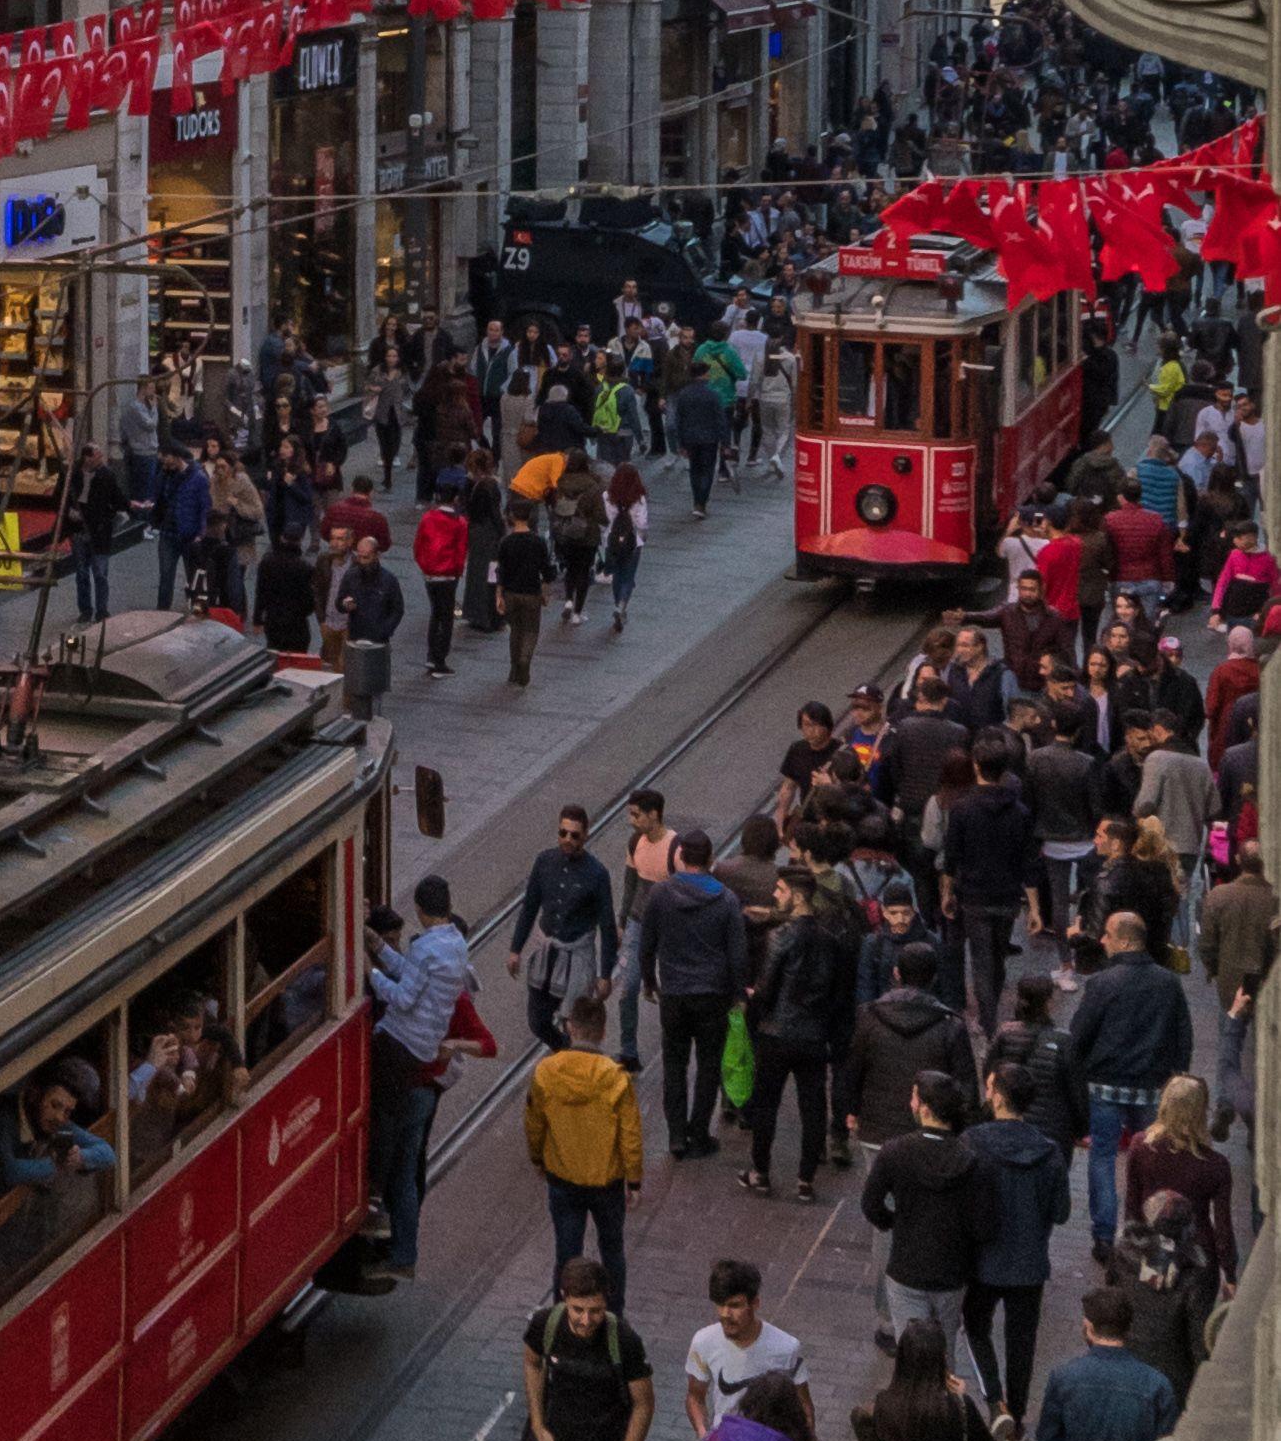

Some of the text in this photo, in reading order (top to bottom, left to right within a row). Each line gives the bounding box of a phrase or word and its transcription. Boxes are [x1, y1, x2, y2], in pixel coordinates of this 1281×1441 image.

[175, 110, 221, 142] TUDORS
[886, 234, 897, 249] 2
[504, 247, 531, 271] Z9
